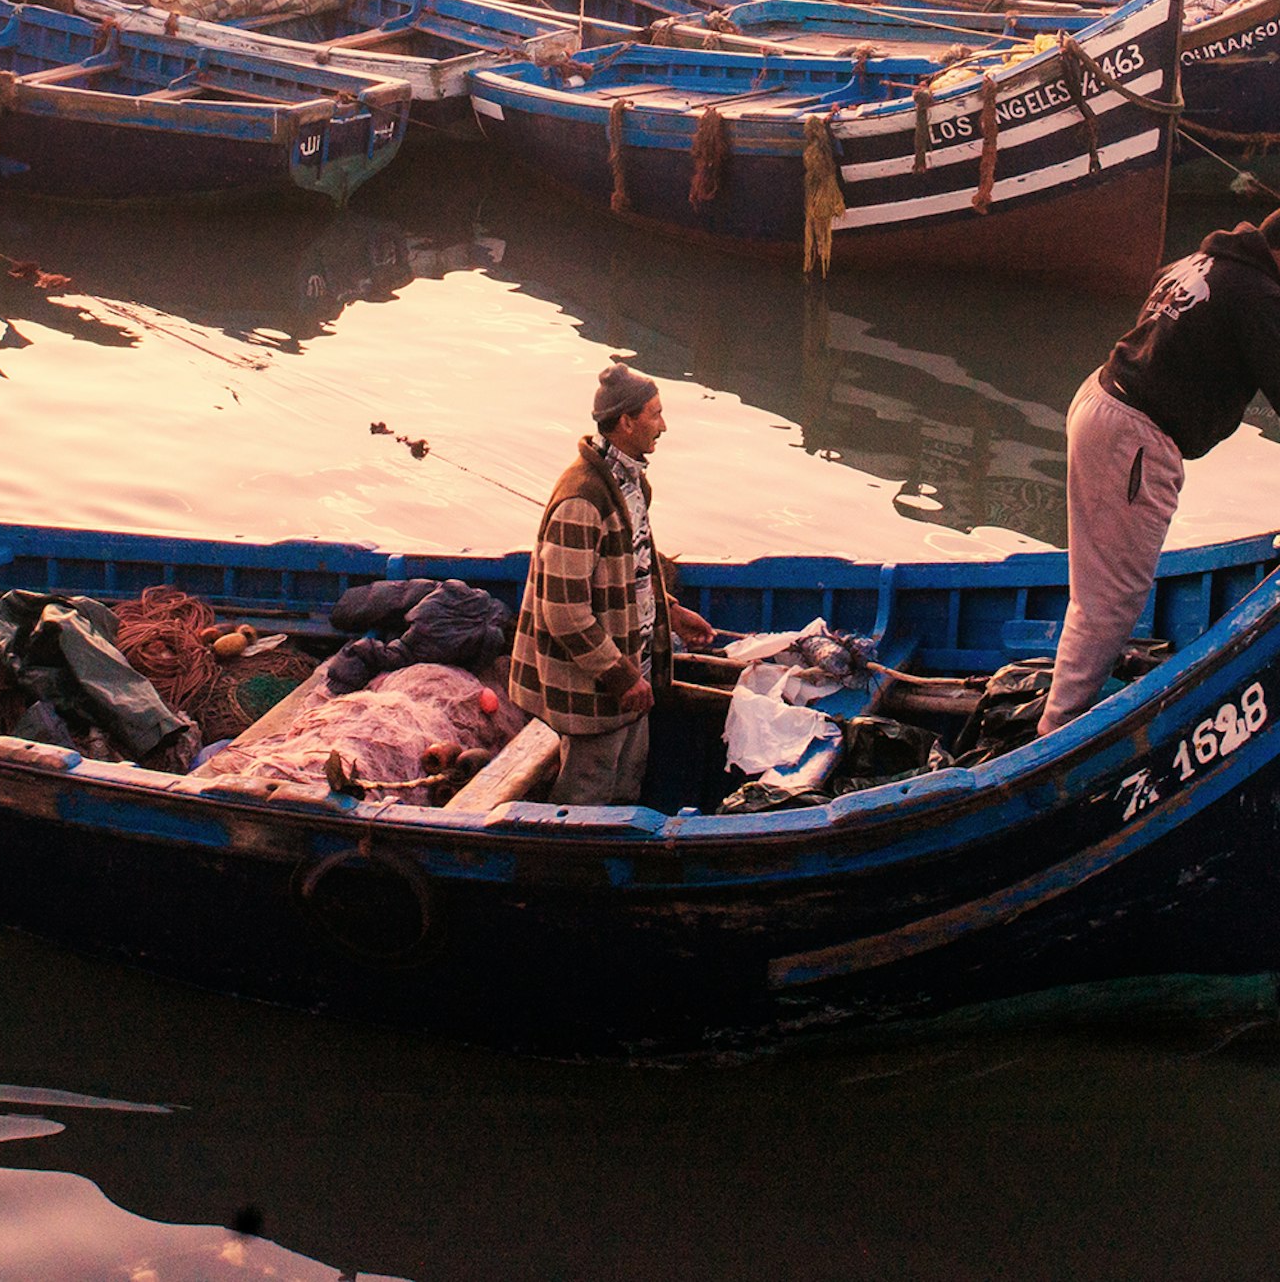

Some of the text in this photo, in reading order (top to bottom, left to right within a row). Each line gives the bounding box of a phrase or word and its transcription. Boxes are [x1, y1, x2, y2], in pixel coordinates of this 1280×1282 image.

[929, 116, 973, 144] LOS
[995, 79, 1071, 125] NGELES
[1173, 681, 1268, 782] 1628
